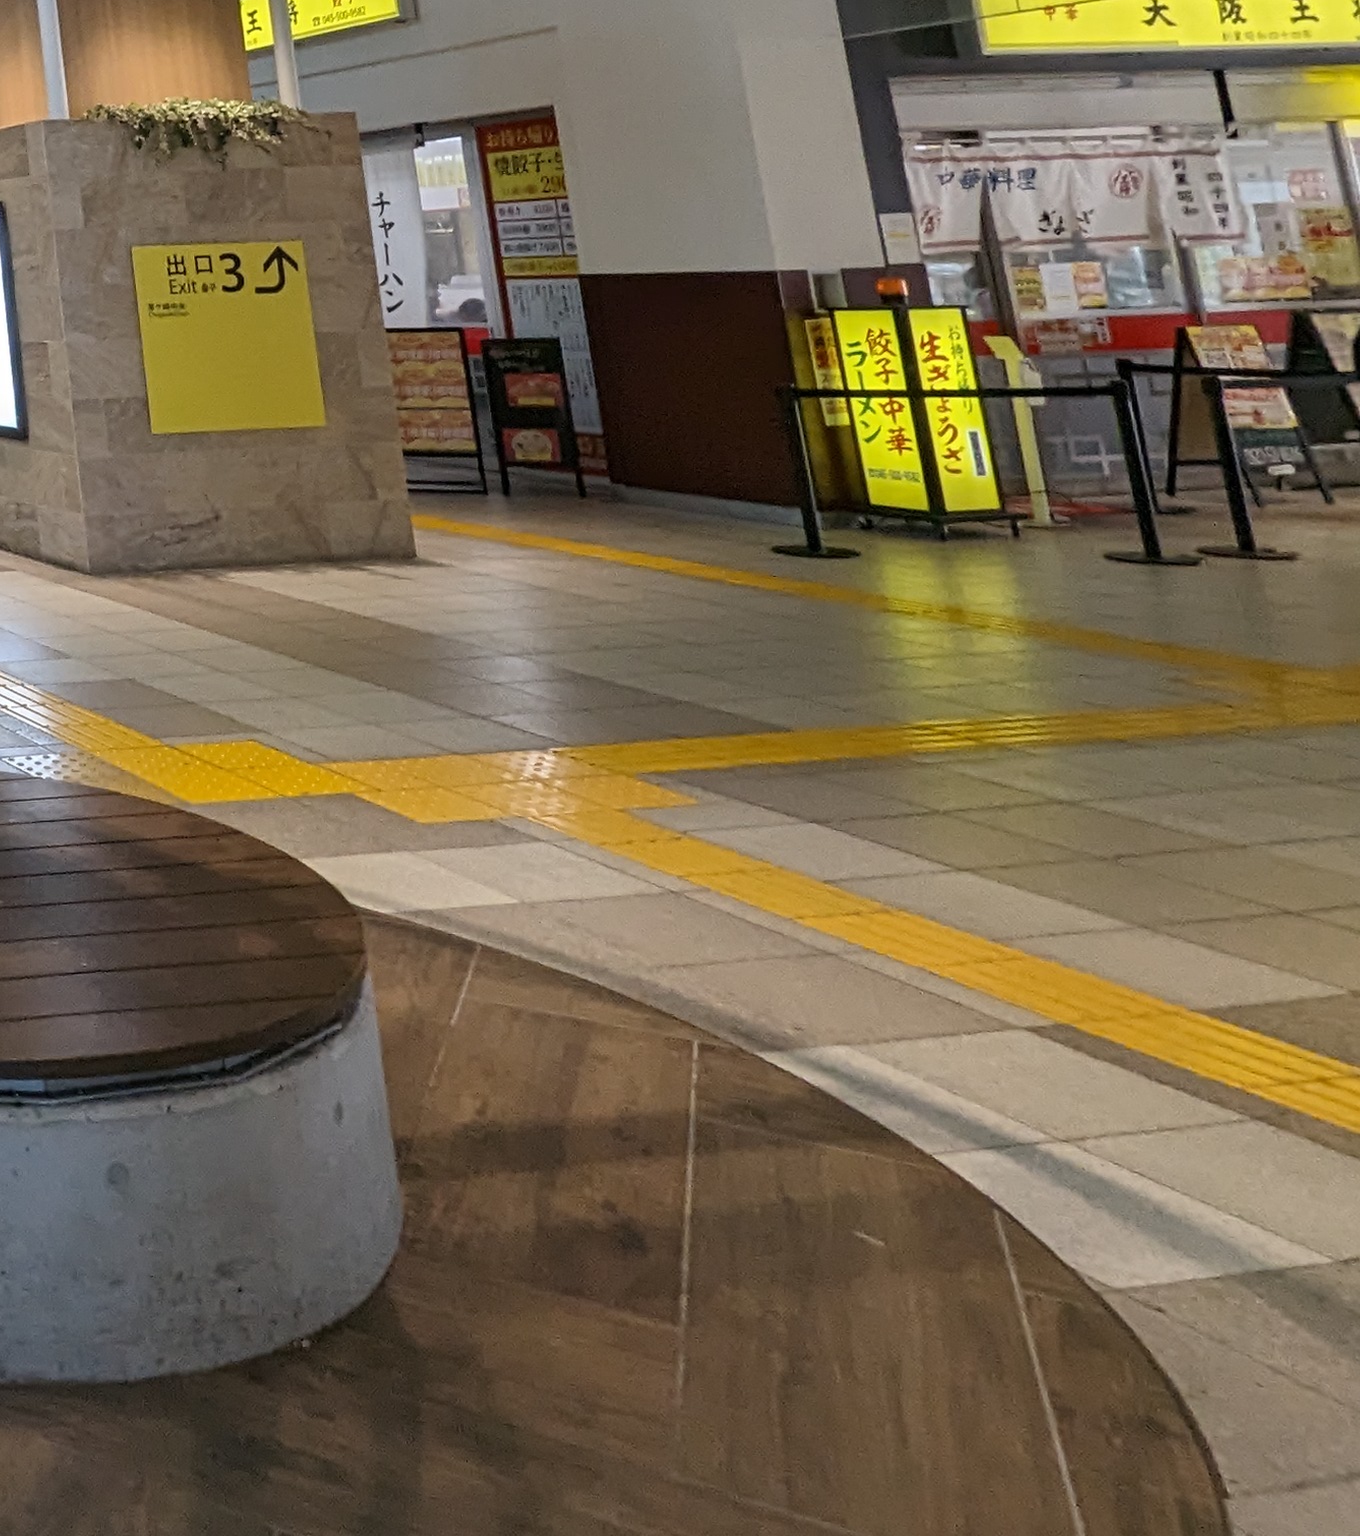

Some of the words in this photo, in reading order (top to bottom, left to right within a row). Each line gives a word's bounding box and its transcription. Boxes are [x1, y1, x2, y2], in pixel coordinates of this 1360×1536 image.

[936, 166, 1037, 193] 中華料理
[371, 191, 404, 314] チャーハン
[166, 253, 214, 277] 出口
[219, 253, 245, 293] 3
[169, 278, 198, 295] Exit
